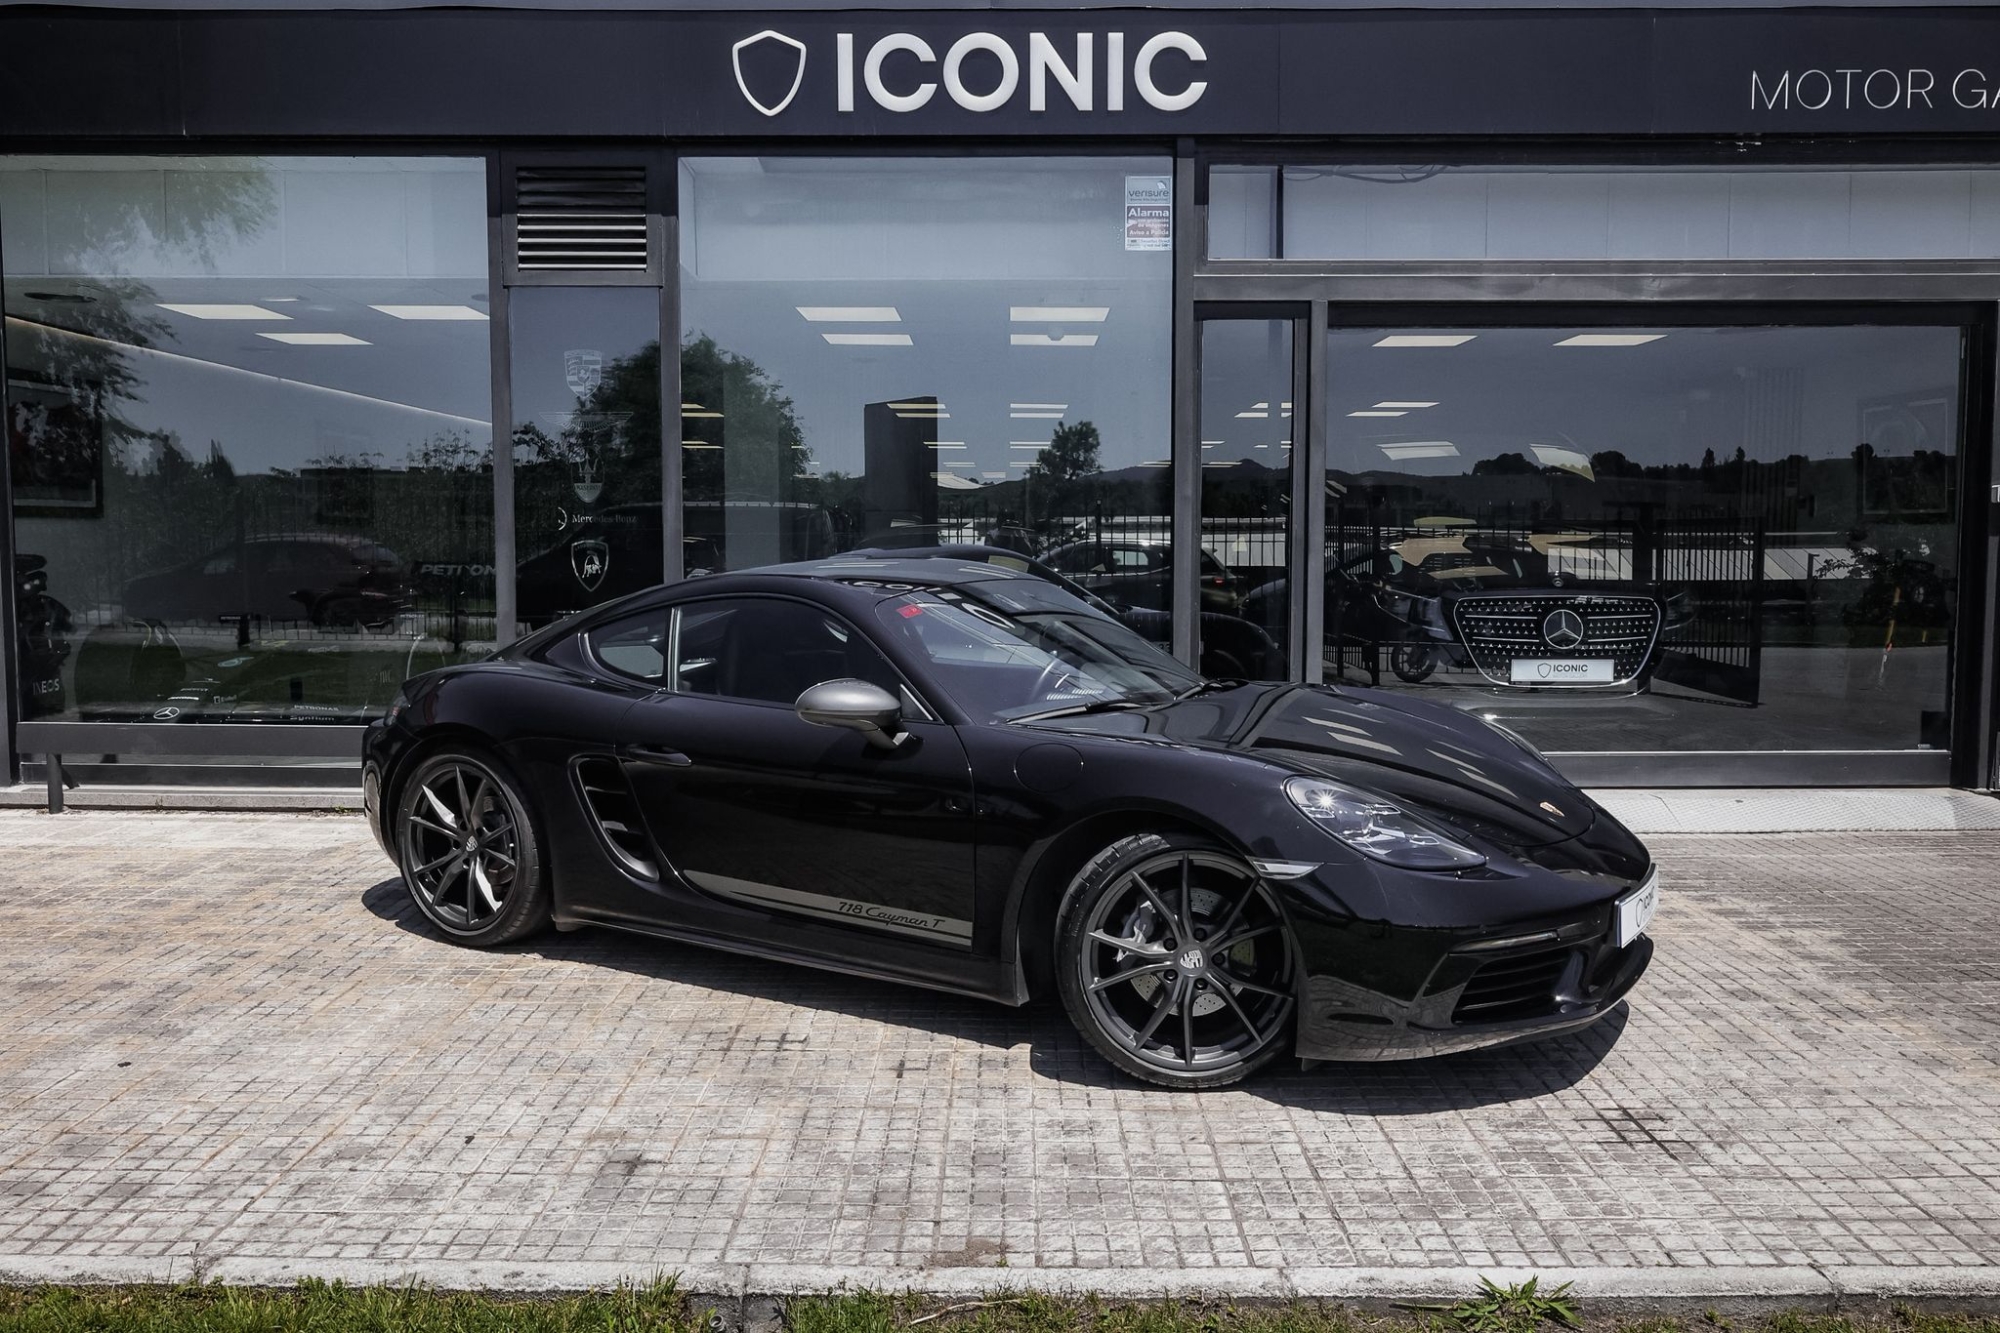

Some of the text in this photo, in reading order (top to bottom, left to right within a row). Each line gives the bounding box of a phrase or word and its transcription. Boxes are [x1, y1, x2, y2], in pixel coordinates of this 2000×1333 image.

[837, 31, 1208, 112] ICONIC
[1751, 69, 1934, 110] MOTOR
[1128, 189, 1169, 197] verisure
[1128, 207, 1170, 217] Alarma
[1553, 664, 1588, 672] ICONIC
[32, 678, 60, 695] INEOS
[839, 902, 945, 928] 718 Cayman T
